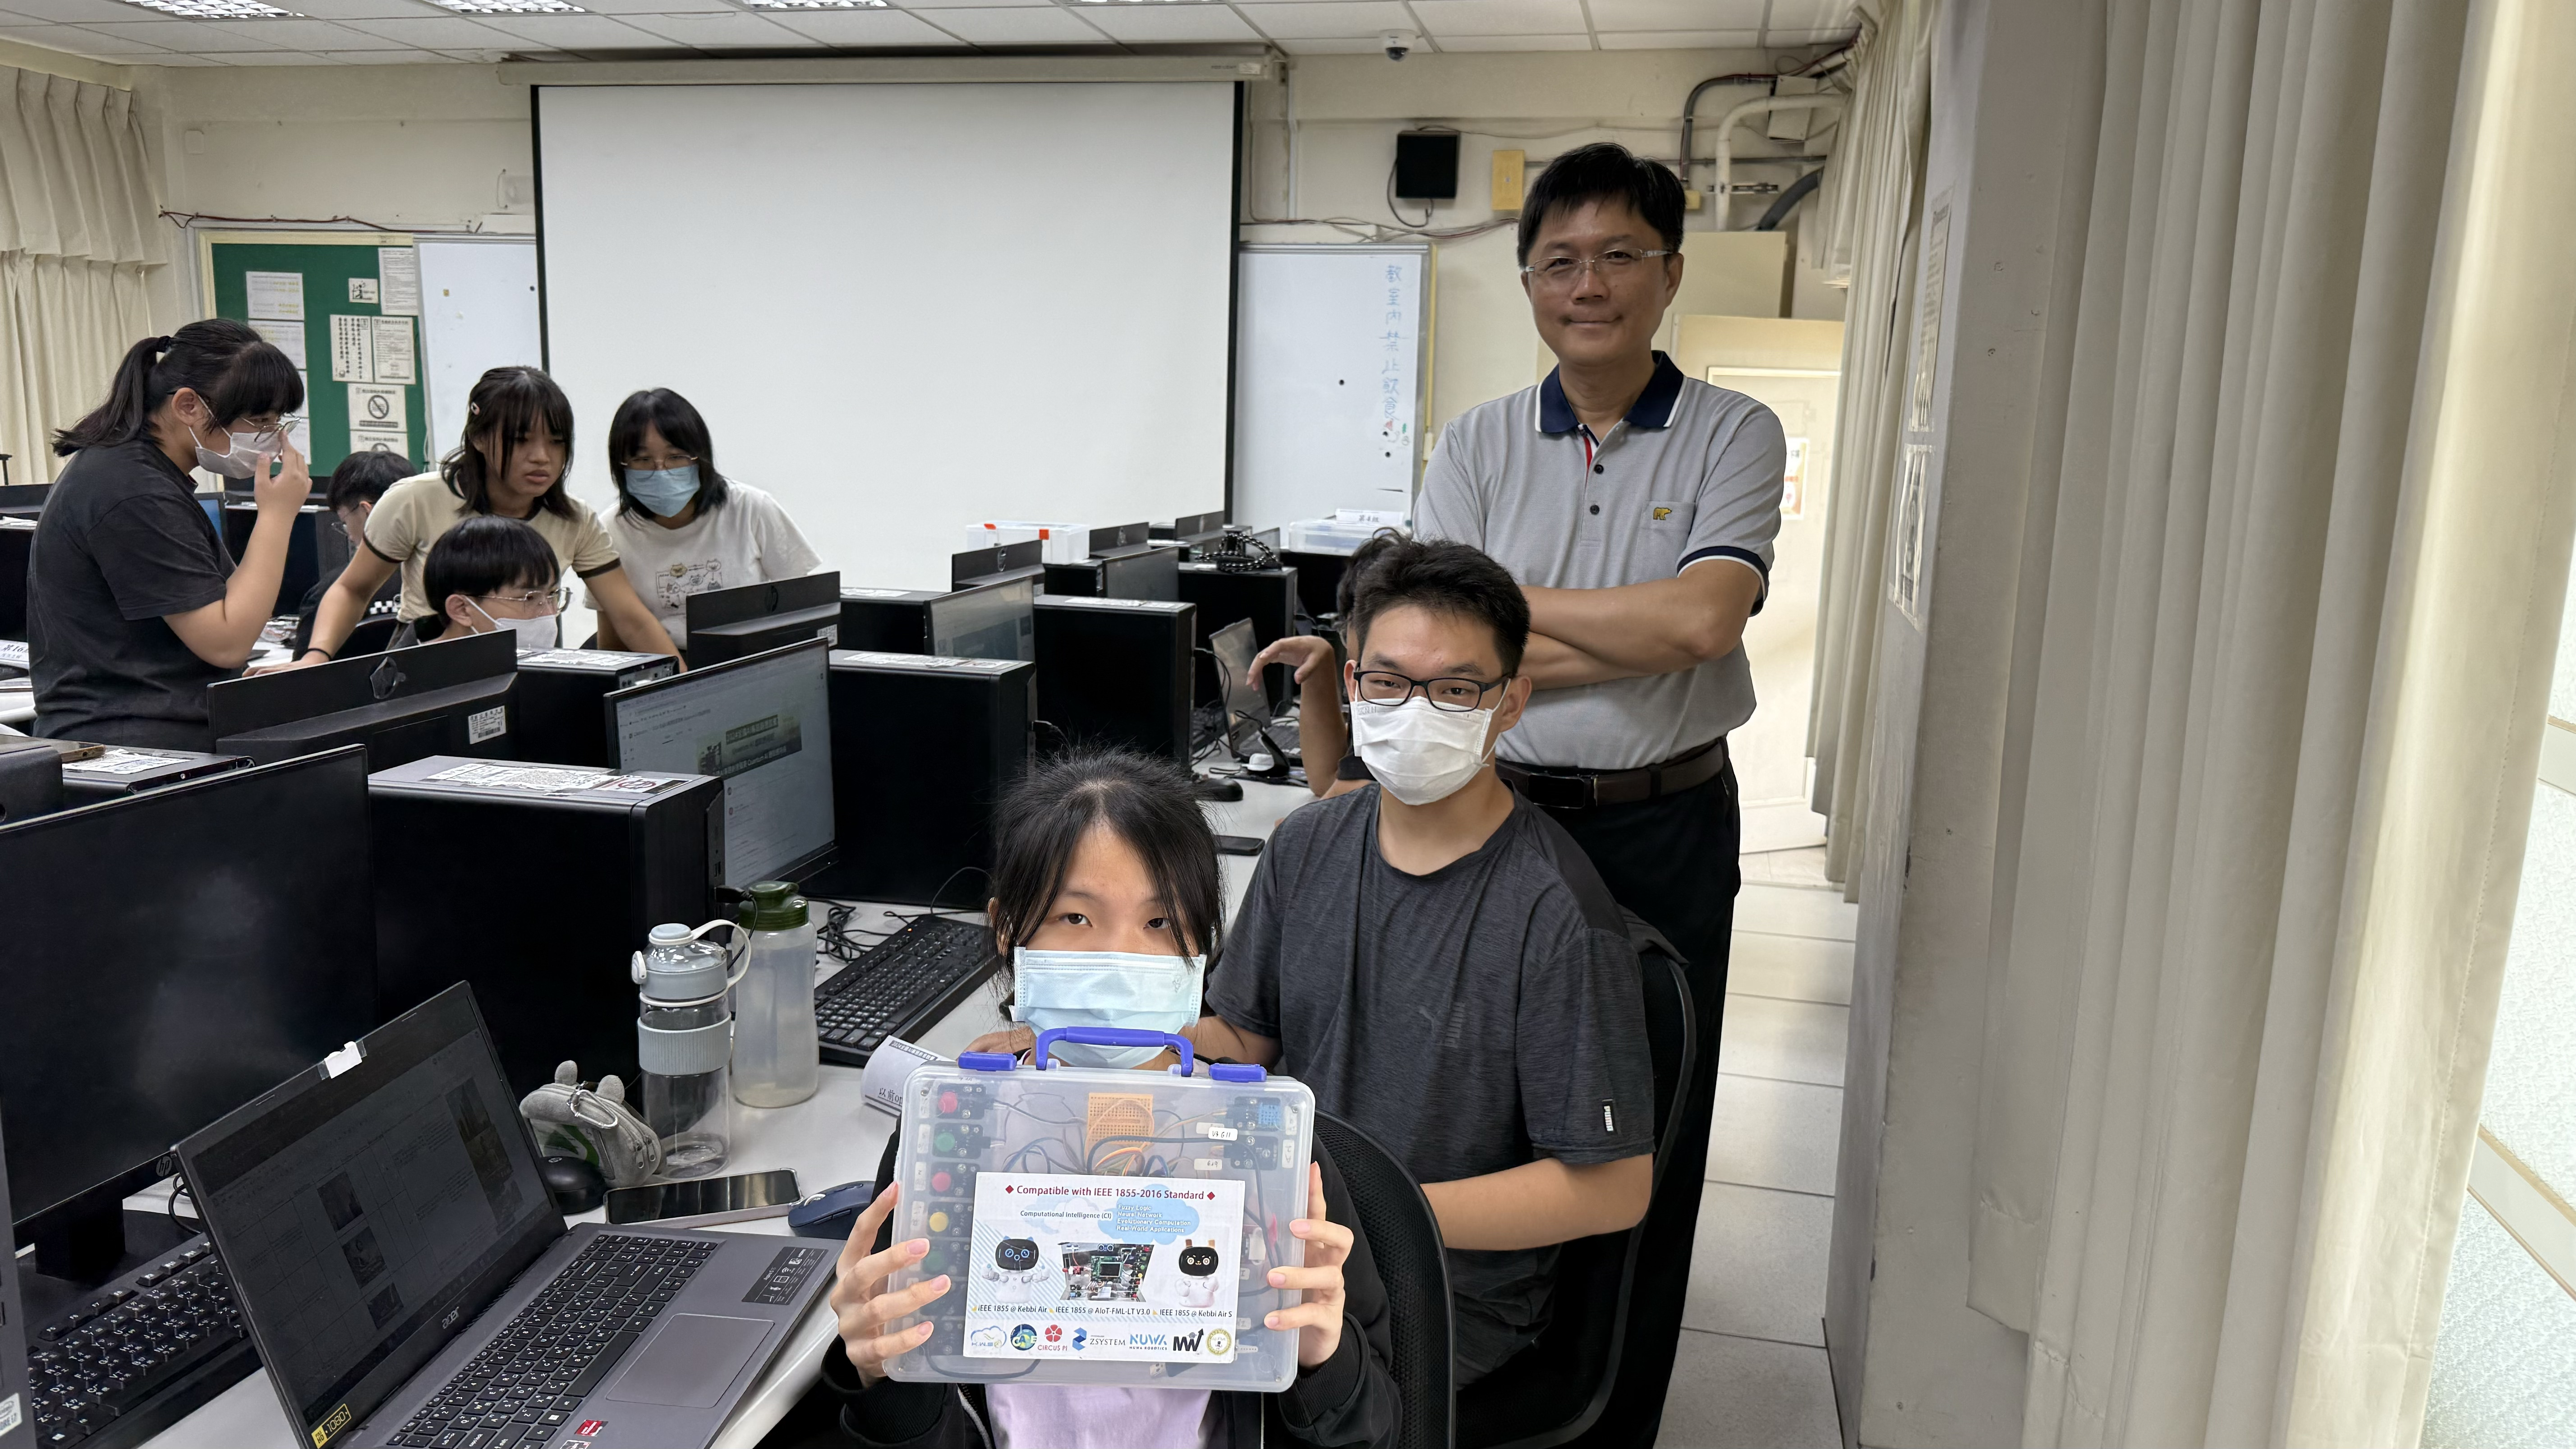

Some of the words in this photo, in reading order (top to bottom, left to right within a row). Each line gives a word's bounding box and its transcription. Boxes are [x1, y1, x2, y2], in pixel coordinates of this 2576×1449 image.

[1017, 1186, 1069, 1196] Compatible
[1072, 1187, 1091, 1196] with
[1094, 1188, 1113, 1196] IEEE
[1115, 1189, 1162, 1198] 1855-2016
[1164, 1190, 1204, 1200] Standard
[442, 1306, 459, 1329] acer
[1130, 1334, 1167, 1345] NUWA
[327, 1411, 346, 1432] 1080
[317, 1434, 325, 1444] HD
